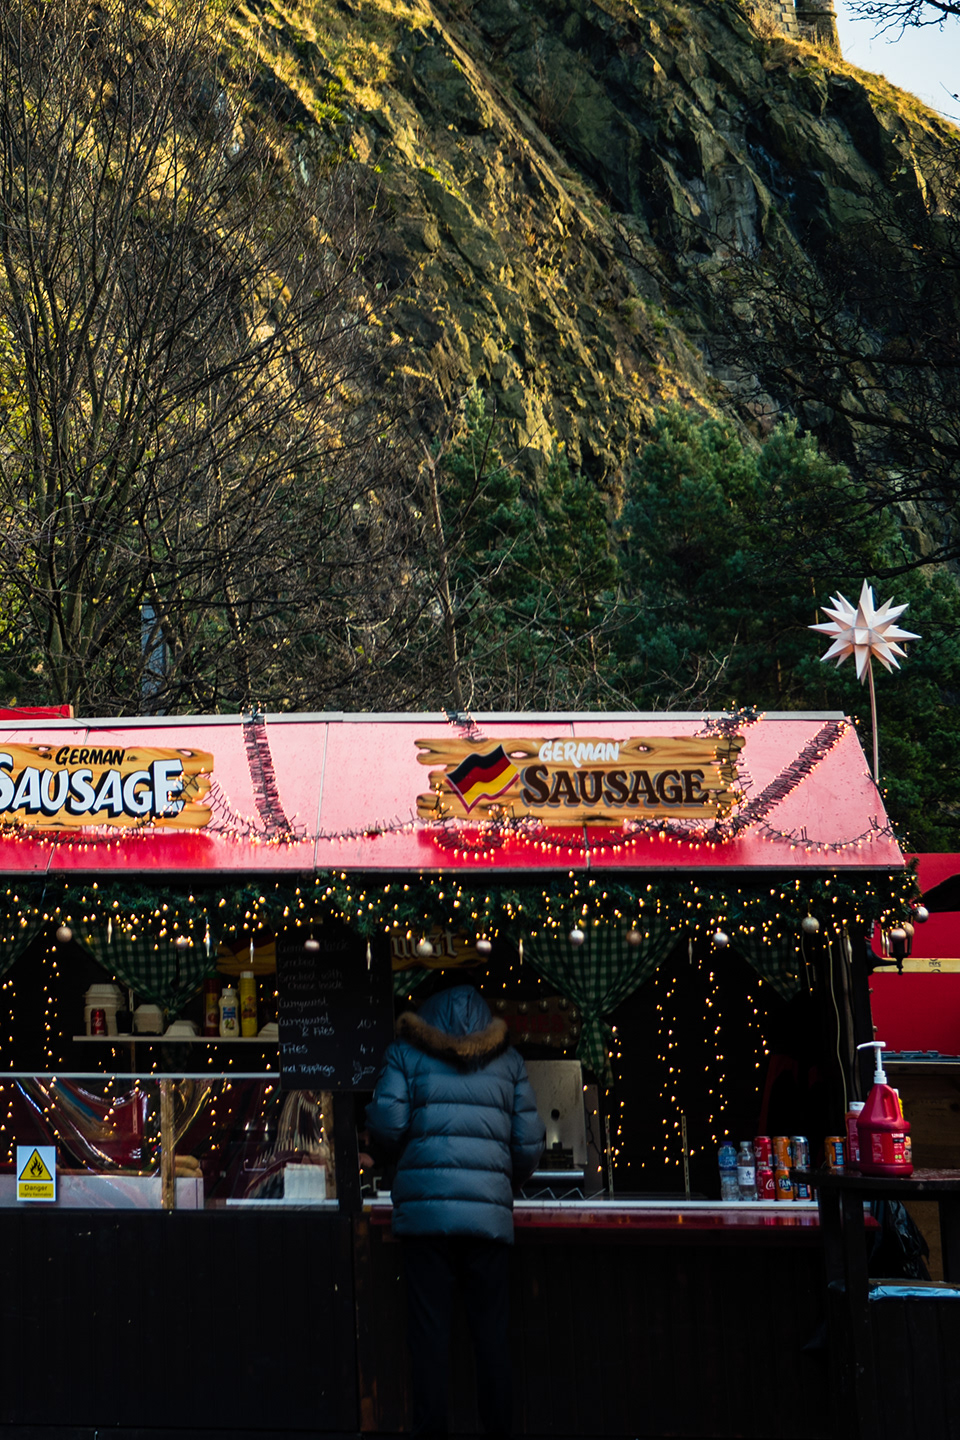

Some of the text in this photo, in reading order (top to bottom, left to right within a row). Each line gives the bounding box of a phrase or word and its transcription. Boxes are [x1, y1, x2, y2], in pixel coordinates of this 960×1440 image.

[55, 746, 125, 766] GERMAN
[539, 741, 620, 768] GERMAN
[521, 765, 709, 808] SAUSAGE
[279, 996, 328, 1013] Currywurst
[279, 1011, 331, 1028] Currywurst
[298, 1063, 336, 1078] Toppings
[24, 1184, 48, 1192] Danger
